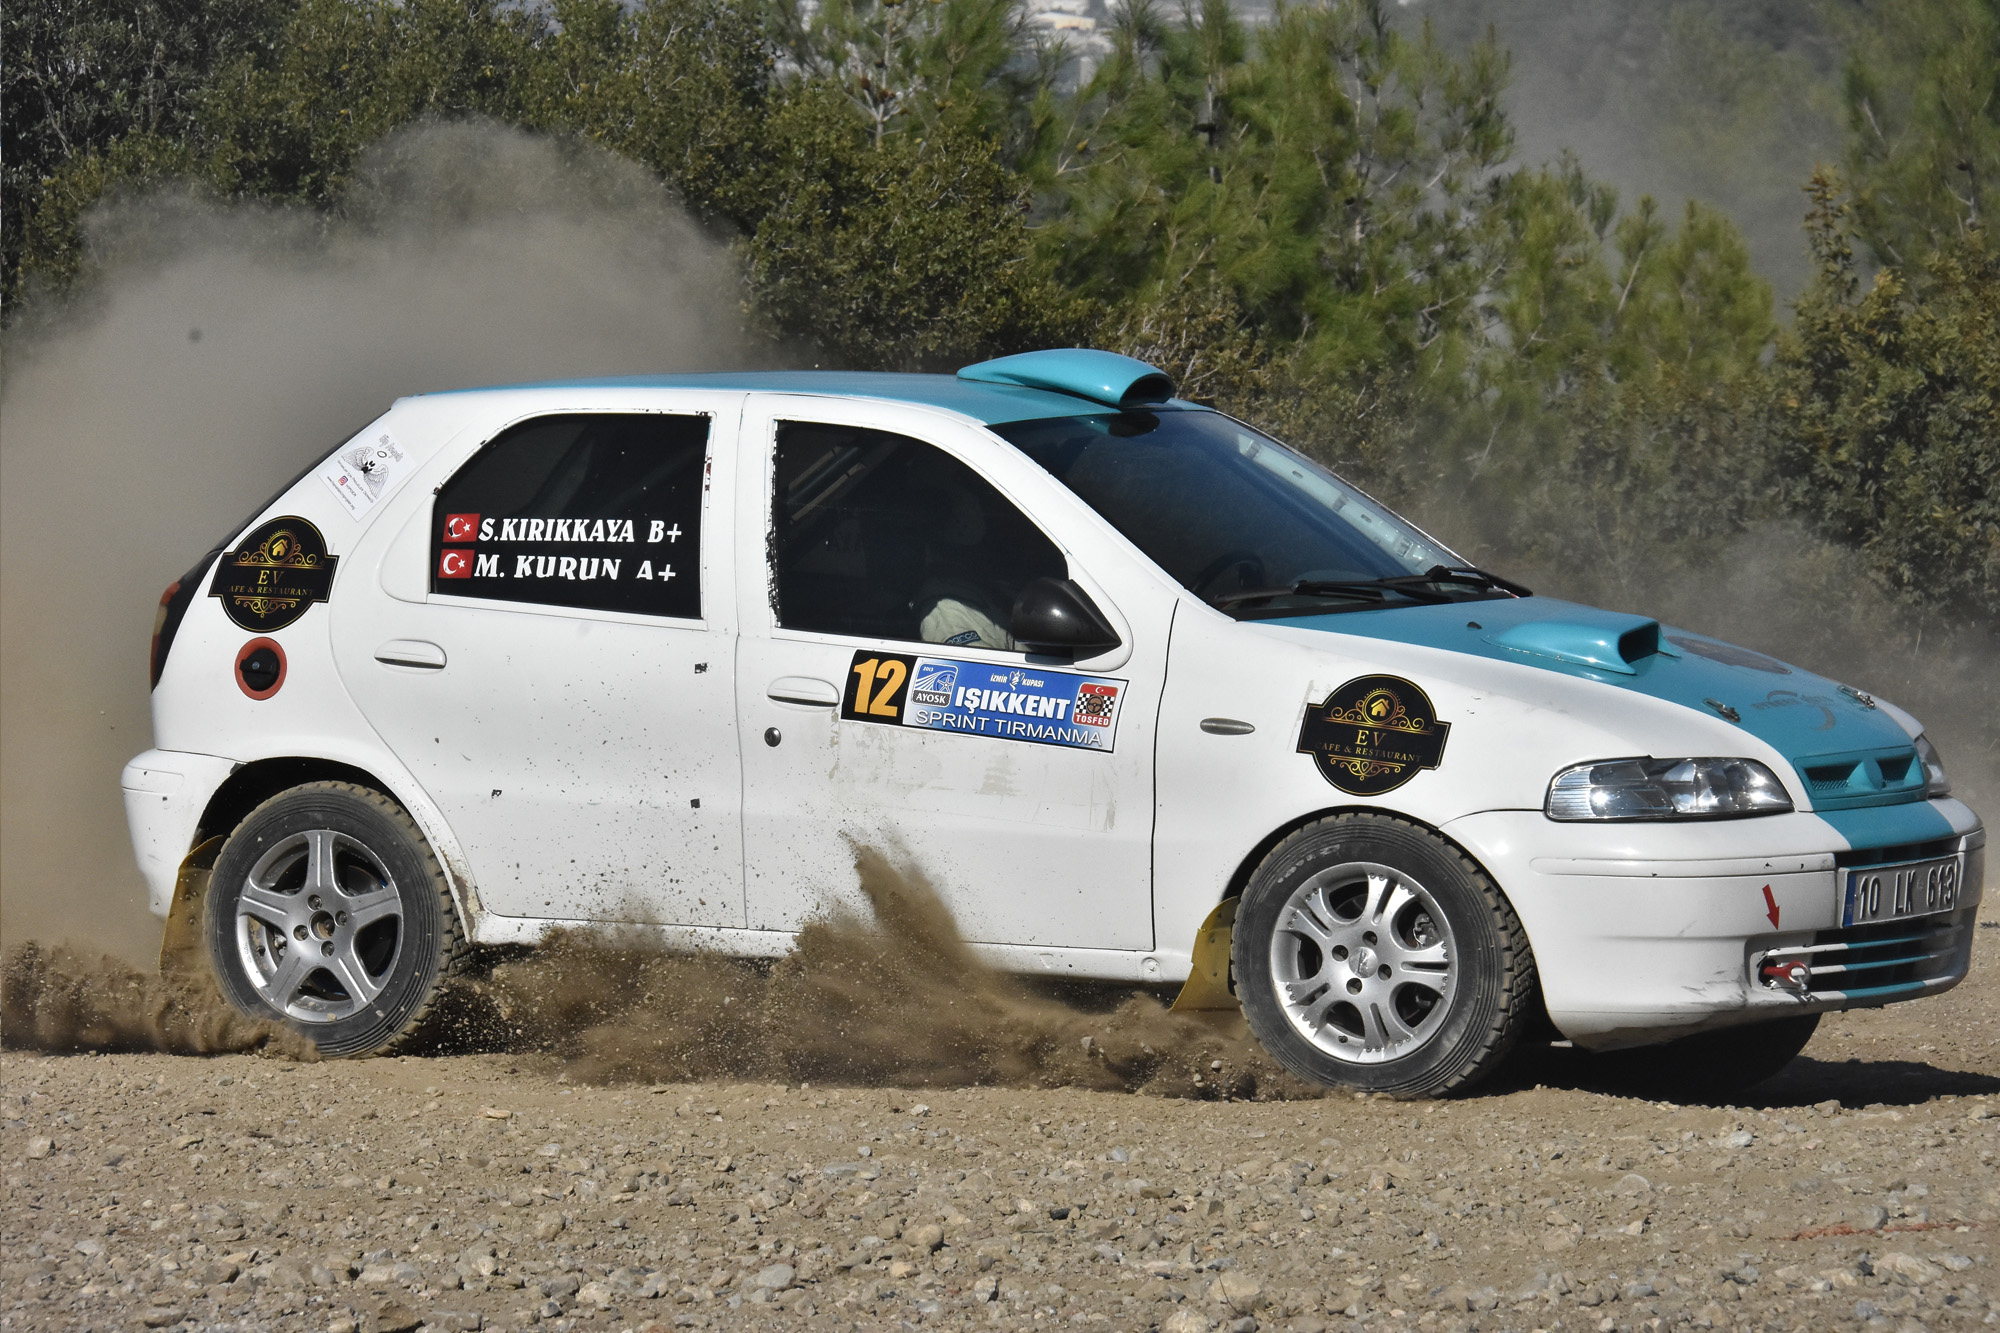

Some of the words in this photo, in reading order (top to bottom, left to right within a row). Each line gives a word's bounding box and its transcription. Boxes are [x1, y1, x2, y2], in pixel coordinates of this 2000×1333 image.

[478, 517, 635, 543] S.KIRIKKAYA
[647, 519, 682, 543] B+
[257, 570, 285, 585] EV
[474, 553, 505, 578] M.
[514, 555, 622, 581] KURUN
[636, 560, 676, 582] A+
[853, 658, 907, 717] 12
[916, 690, 947, 704] AYOSK
[955, 686, 1071, 720] IŞIKKENT
[916, 709, 991, 733] SPRINT
[995, 718, 1103, 746] TIRMANMA
[1076, 714, 1110, 727] TOSFED
[1355, 729, 1387, 747] EV
[1344, 745, 1352, 753] &
[1355, 746, 1423, 762] RESTAURANT
[1859, 875, 1881, 920] 10
[1893, 869, 1916, 916] LK
[1926, 863, 1954, 909] 613
